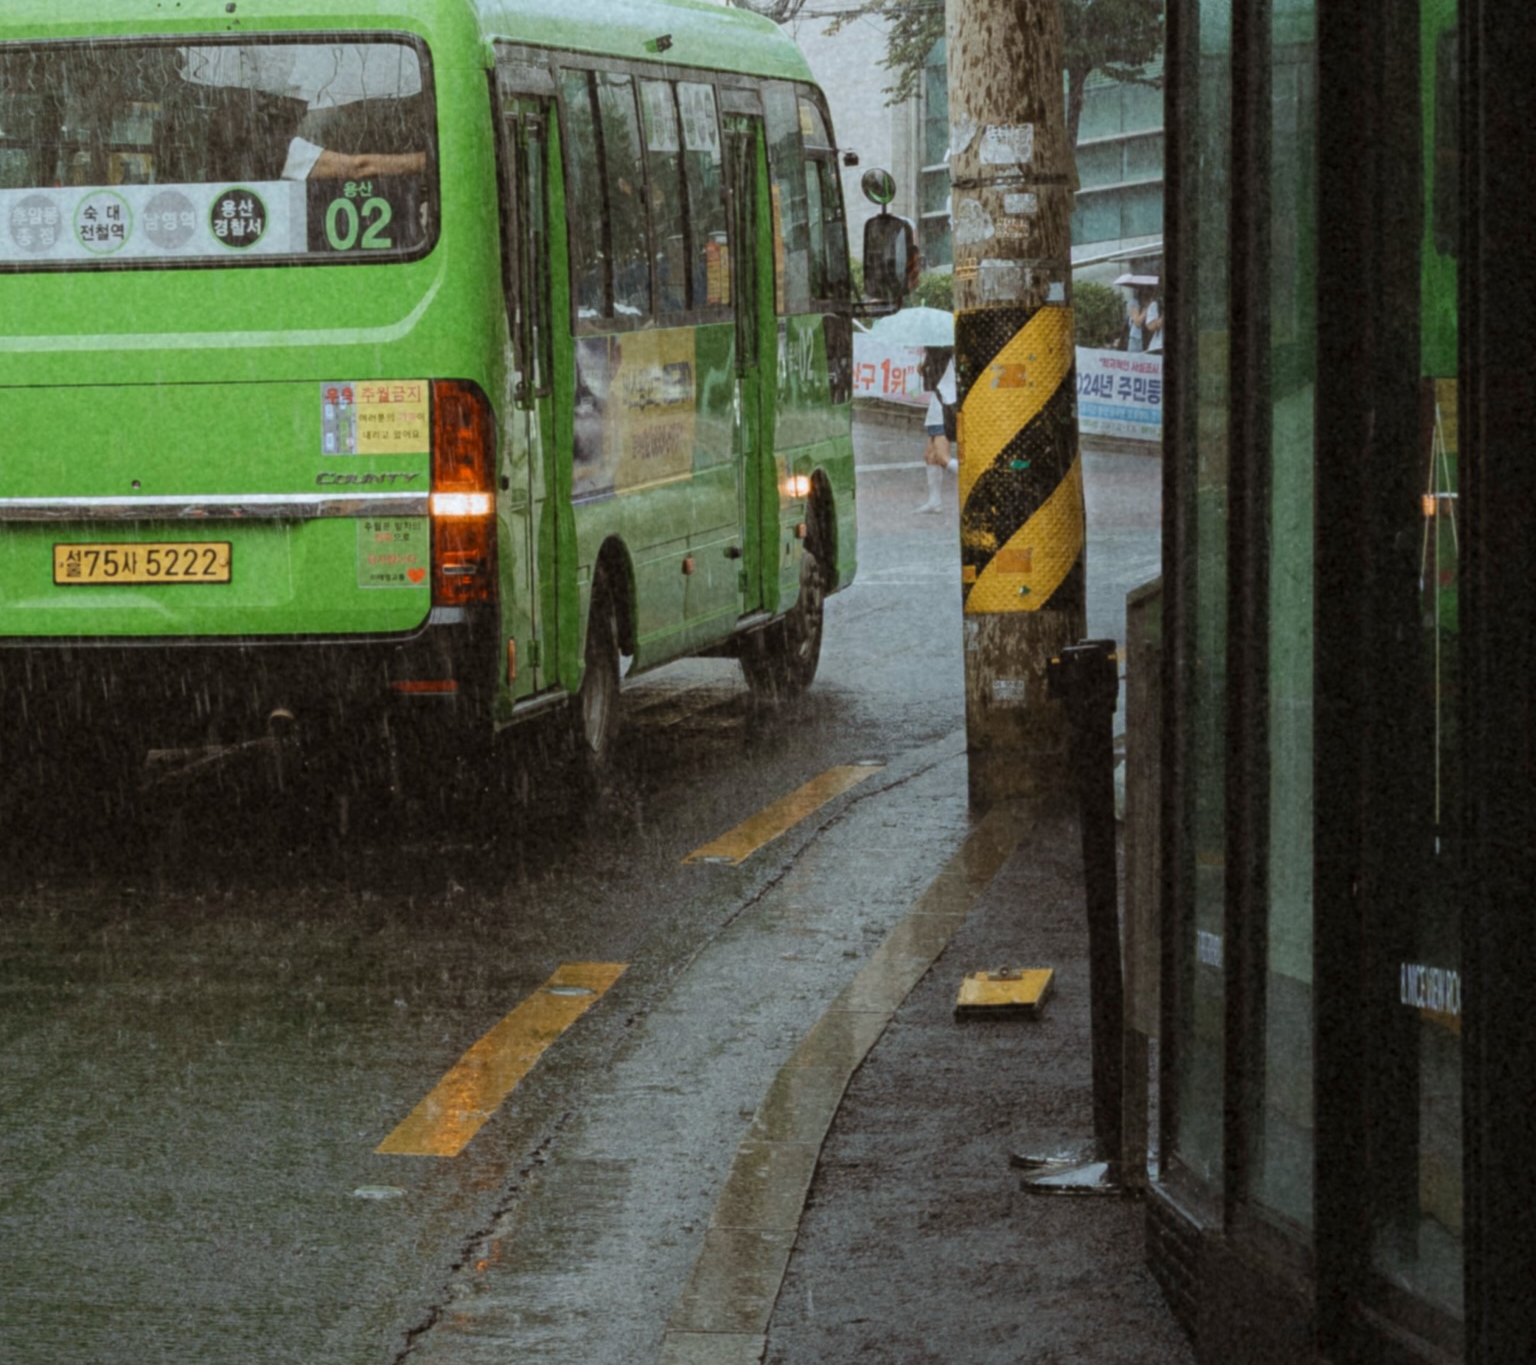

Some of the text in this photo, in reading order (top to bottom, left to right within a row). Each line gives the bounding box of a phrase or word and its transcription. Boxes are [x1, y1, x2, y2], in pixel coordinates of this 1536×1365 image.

[343, 181, 372, 197] 용산
[221, 199, 254, 217] 용산
[80, 223, 125, 242] 전철역
[214, 218, 262, 237] 경찰서
[325, 196, 393, 251] 02
[361, 385, 422, 404] 추월금지
[145, 548, 218, 577] 5222
